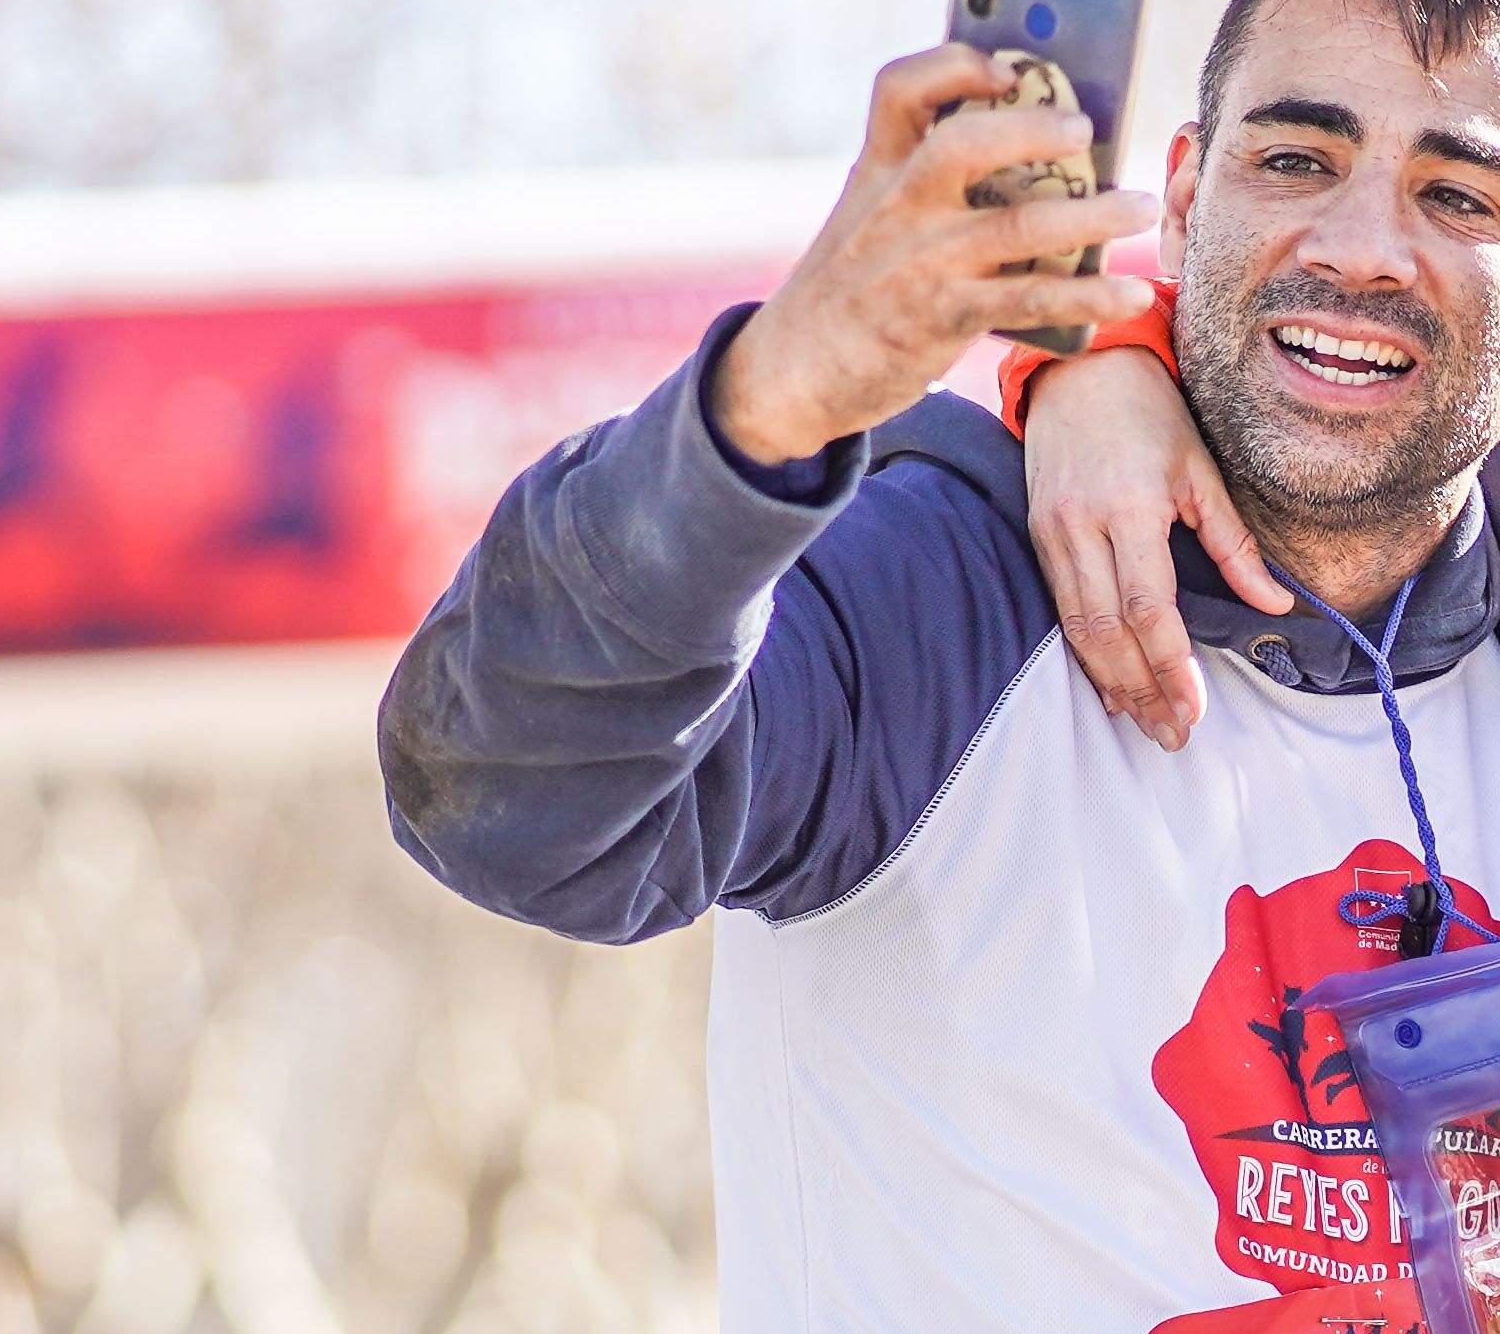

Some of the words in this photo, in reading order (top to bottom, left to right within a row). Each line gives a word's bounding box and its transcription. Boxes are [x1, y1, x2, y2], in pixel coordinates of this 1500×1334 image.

[1358, 930, 1400, 942] Comunid
[1358, 939, 1372, 949] de
[1375, 940, 1398, 952] Mad
[1272, 1120, 1379, 1150] CARRERA
[1236, 1155, 1370, 1244] REYES
[1238, 1236, 1388, 1285] COMUNIDAD
